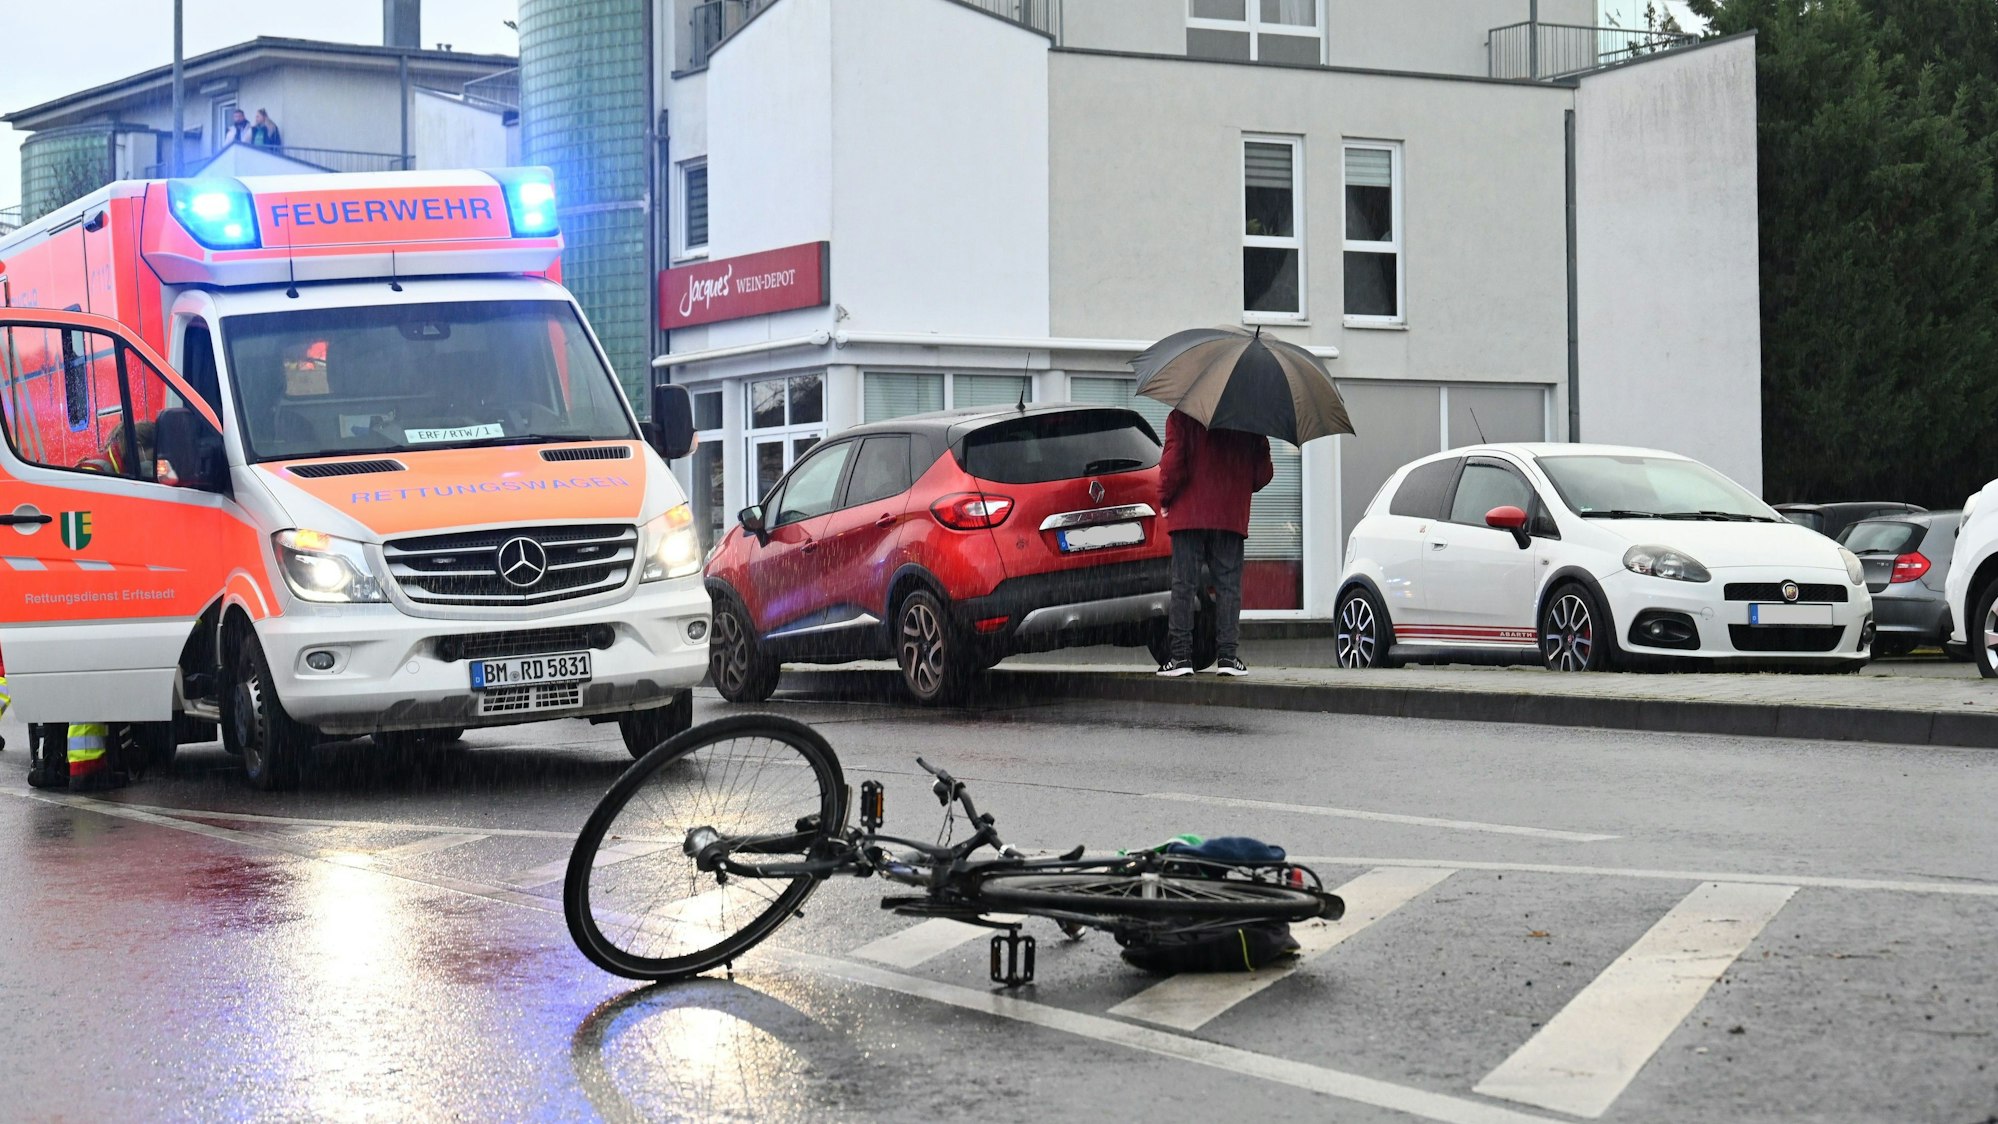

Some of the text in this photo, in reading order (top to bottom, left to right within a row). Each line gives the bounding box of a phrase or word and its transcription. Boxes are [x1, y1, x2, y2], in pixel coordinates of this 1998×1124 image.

[271, 197, 492, 227] FEUERWEHR
[736, 269, 796, 294] WEIN-DEPOT
[418, 427, 491, 440] ERF/RTW/1
[351, 476, 629, 504] RETTUNGSWAGEN
[25, 588, 175, 605] Rettungsdienst Erftstadt
[485, 662, 508, 683] BM
[521, 660, 543, 681] RD
[547, 656, 589, 678] 5831
